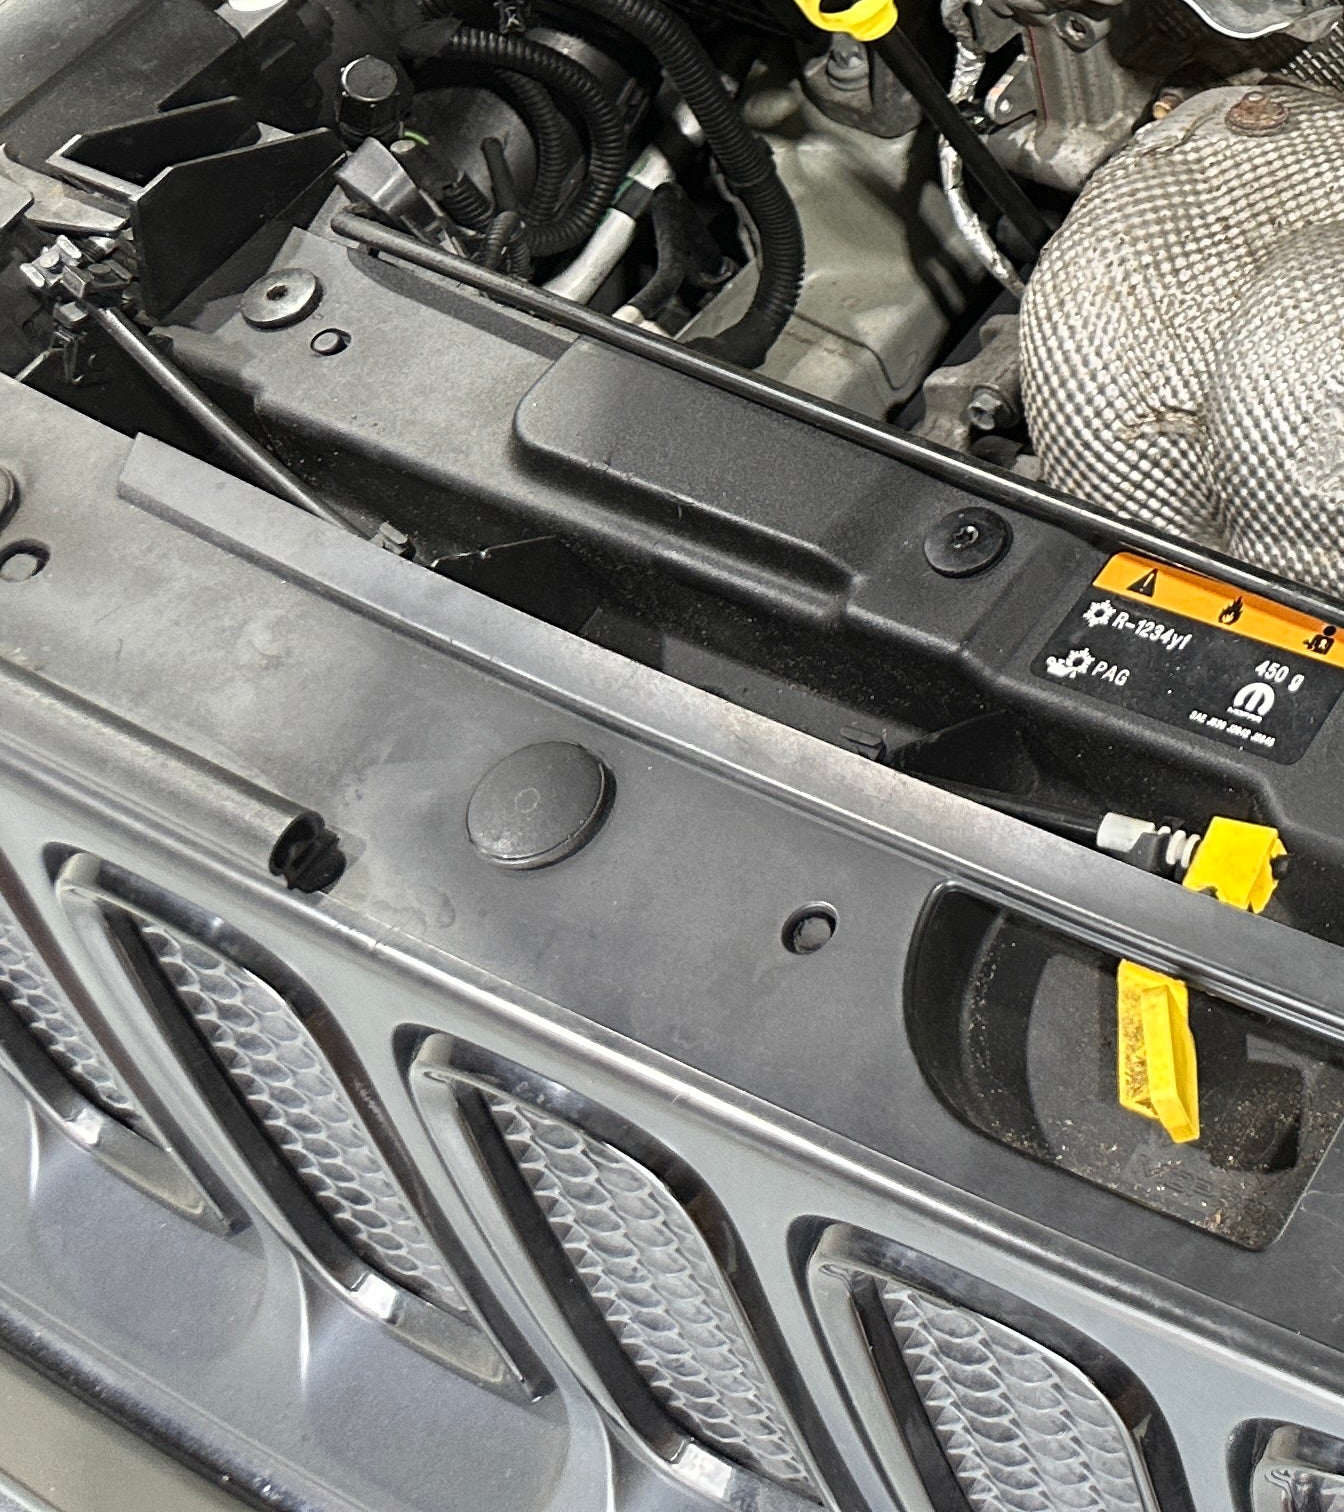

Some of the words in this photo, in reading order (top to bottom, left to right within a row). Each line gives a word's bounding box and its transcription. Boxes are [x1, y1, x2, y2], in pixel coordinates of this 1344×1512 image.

[1112, 611, 1193, 650] R-1234yf
[1091, 661, 1132, 687] PAG
[1254, 659, 1290, 684] 450
[1288, 673, 1305, 692] g
